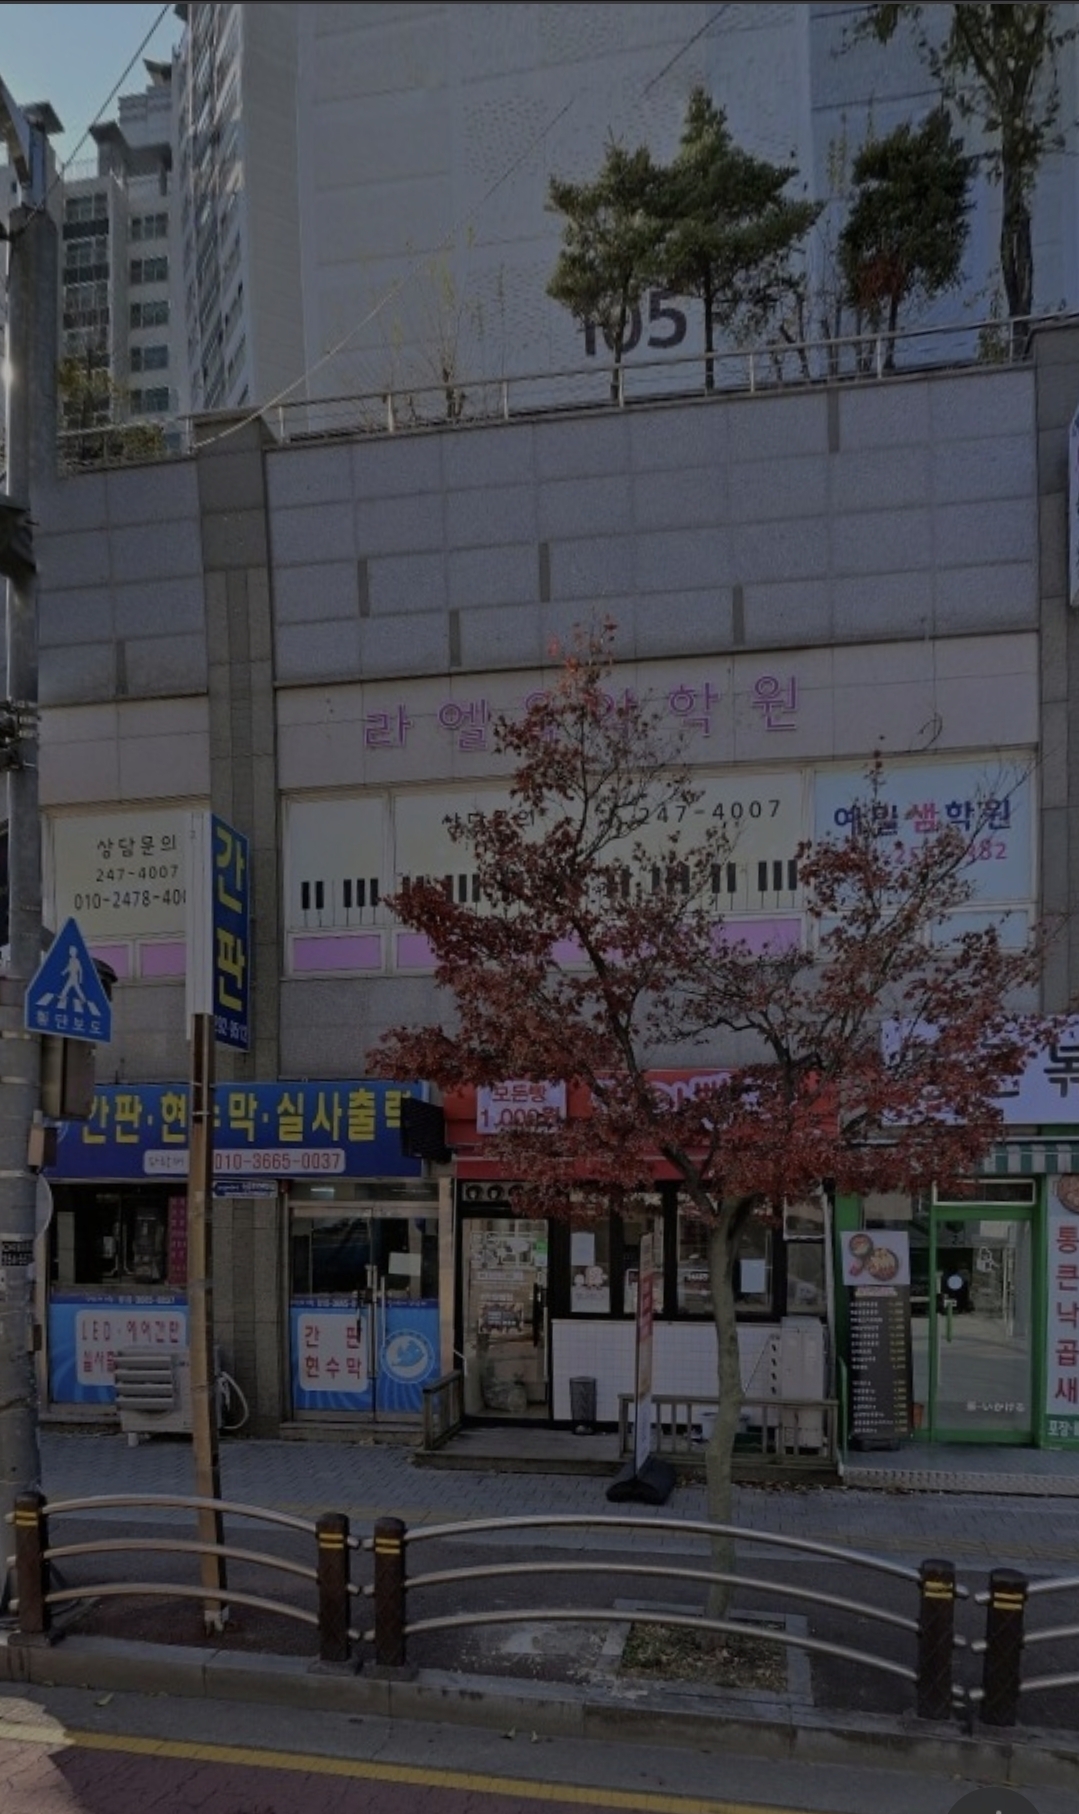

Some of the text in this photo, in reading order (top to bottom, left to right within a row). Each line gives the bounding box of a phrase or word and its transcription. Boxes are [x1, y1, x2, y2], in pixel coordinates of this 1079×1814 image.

[97, 834, 177, 860] 상담문의
[96, 864, 179, 883] 247-4007
[215, 825, 246, 1013] 간판
[214, 1152, 341, 1171] 010-3665-0037
